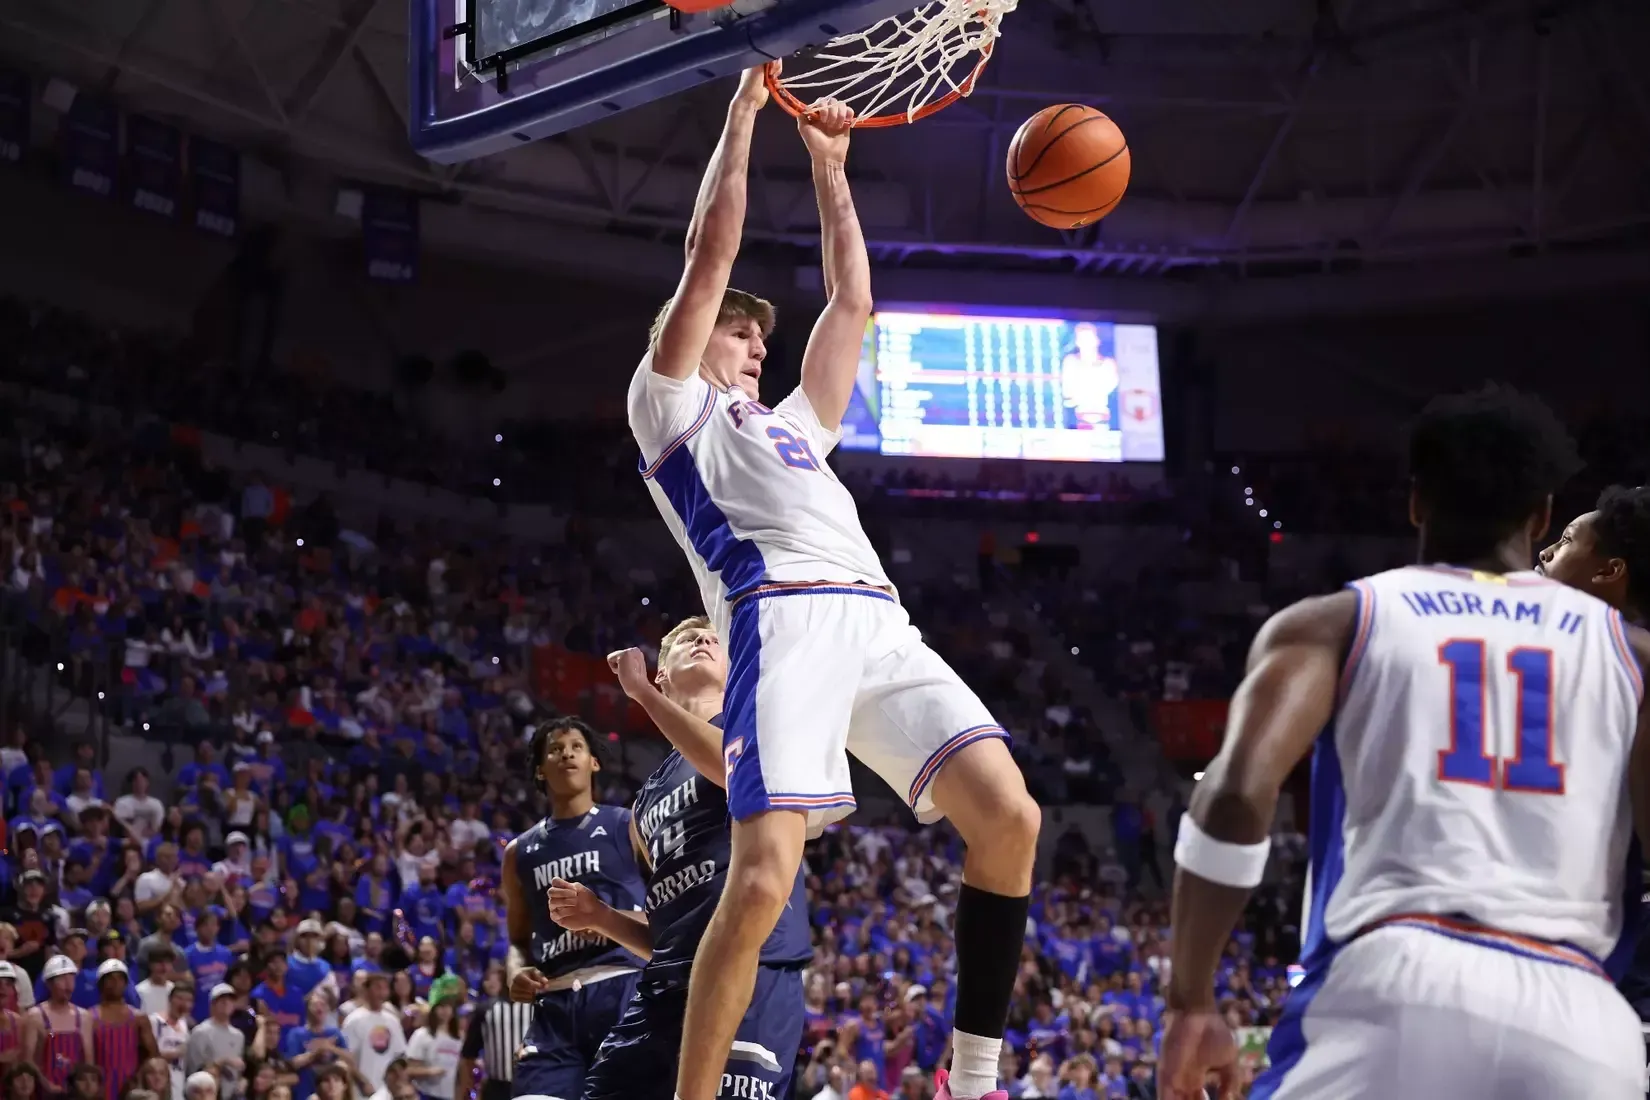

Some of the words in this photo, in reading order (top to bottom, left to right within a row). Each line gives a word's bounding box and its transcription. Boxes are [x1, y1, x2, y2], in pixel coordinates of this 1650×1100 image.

[1401, 591, 1541, 625] INGRAM
[1557, 610, 1584, 635] II
[1437, 637, 1565, 795] 11
[640, 776, 699, 846] NORTH
[533, 850, 600, 891] NORTH
[645, 860, 716, 914] LORIDA
[716, 1073, 777, 1100] PREY
